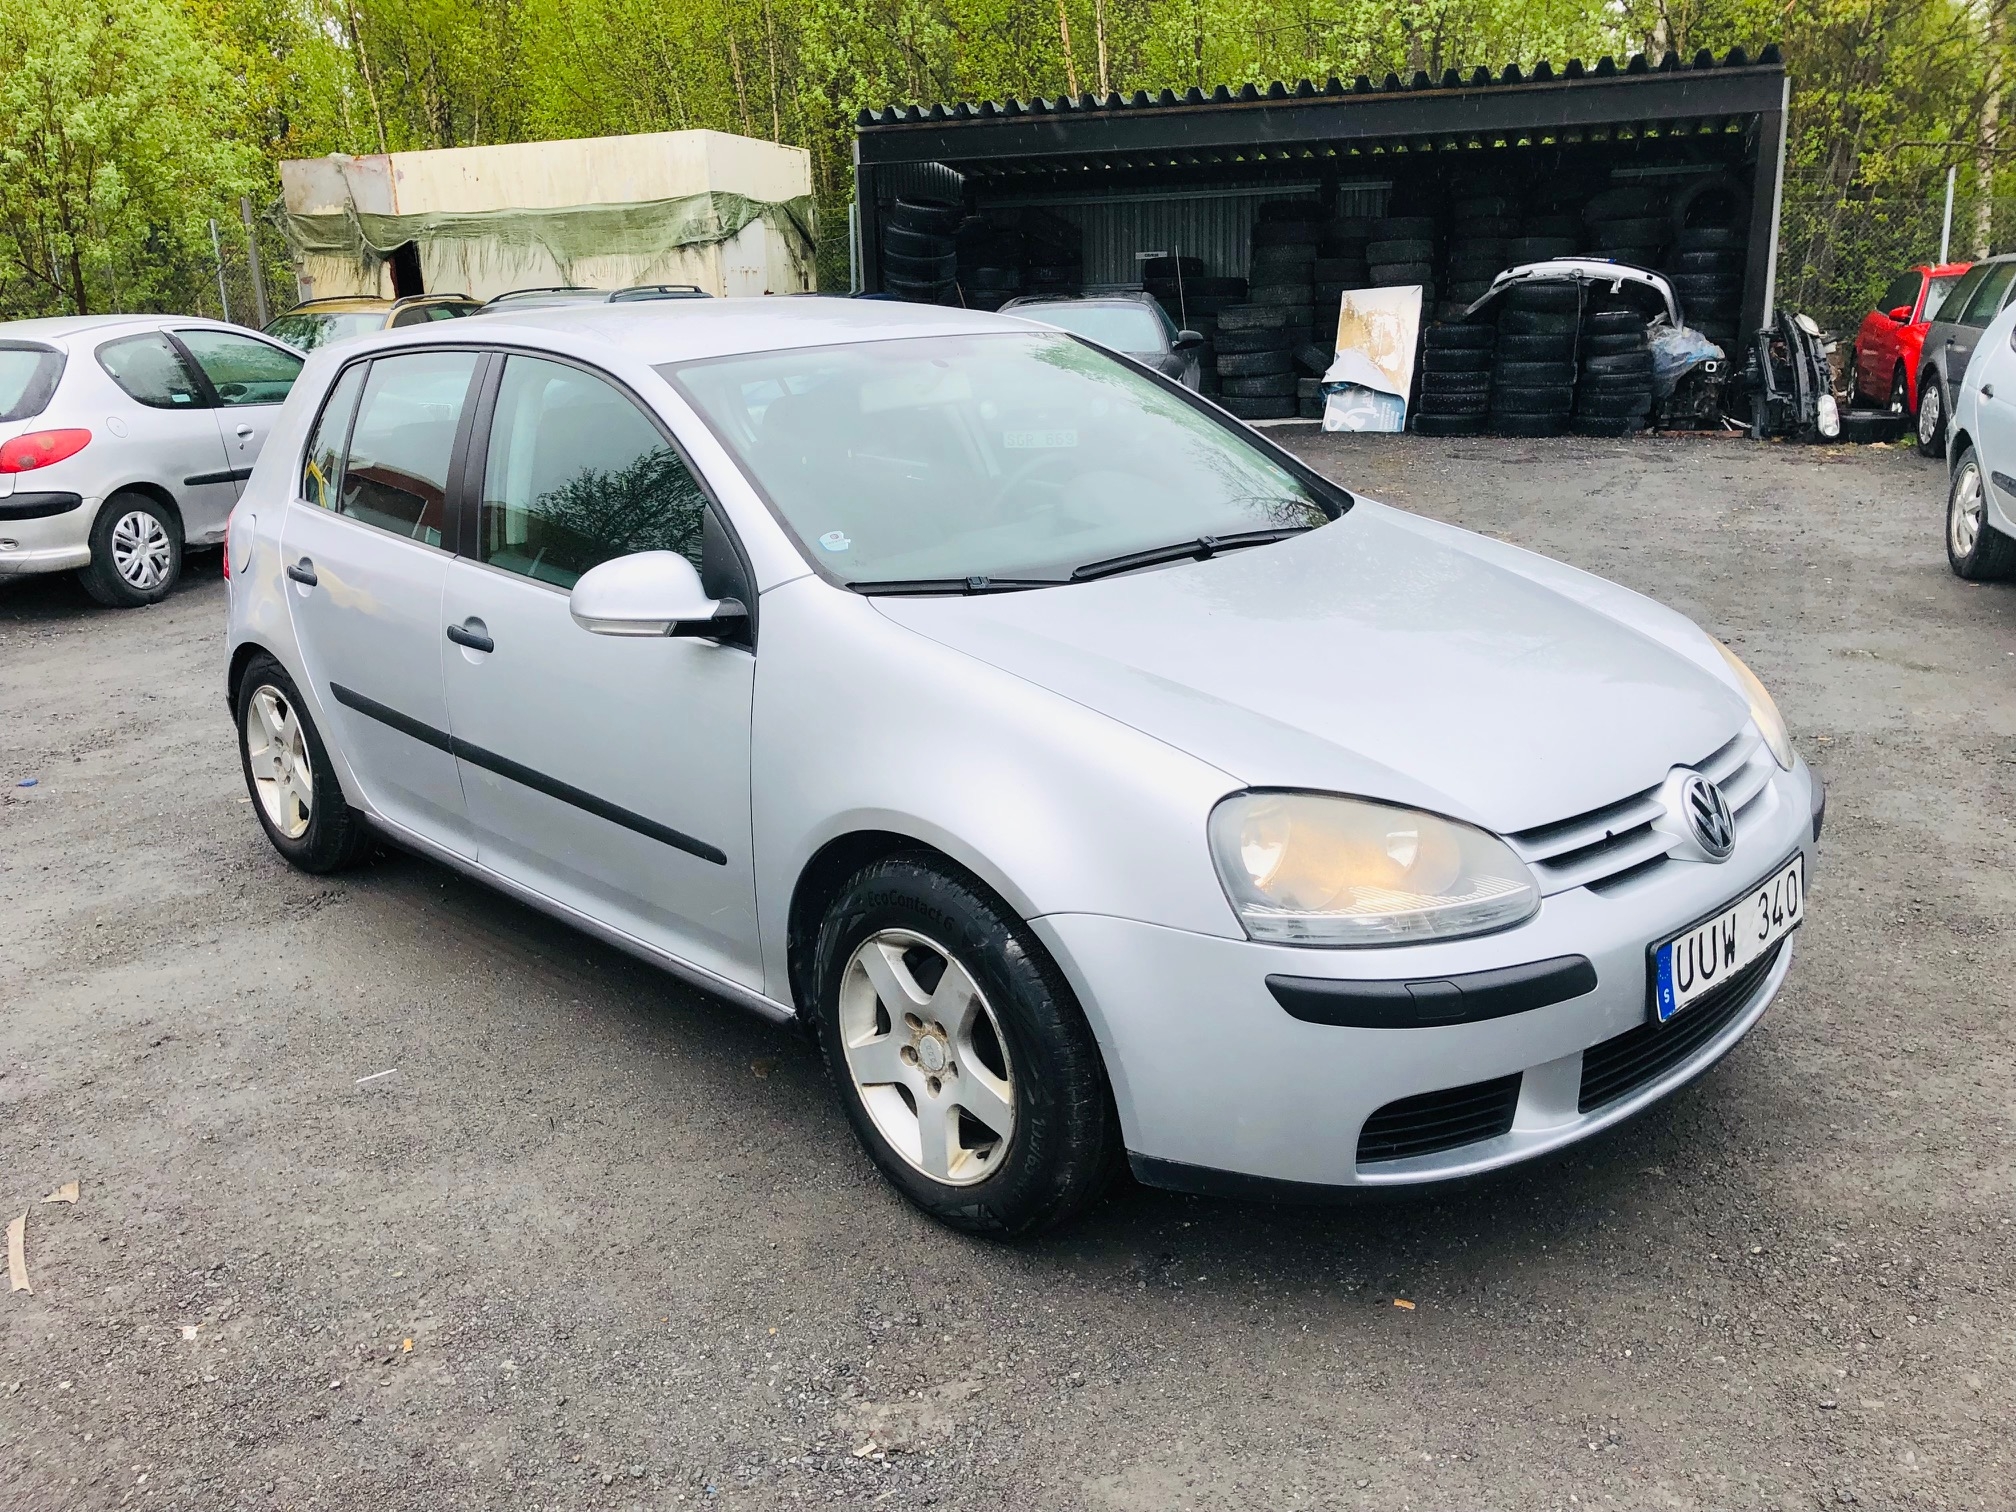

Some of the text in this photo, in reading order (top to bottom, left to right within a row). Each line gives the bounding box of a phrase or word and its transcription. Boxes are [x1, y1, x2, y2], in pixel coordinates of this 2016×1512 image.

[867, 889, 943, 924] EcoContact
[1676, 869, 1798, 993] UUW 340
[1663, 988, 1670, 1004] S
